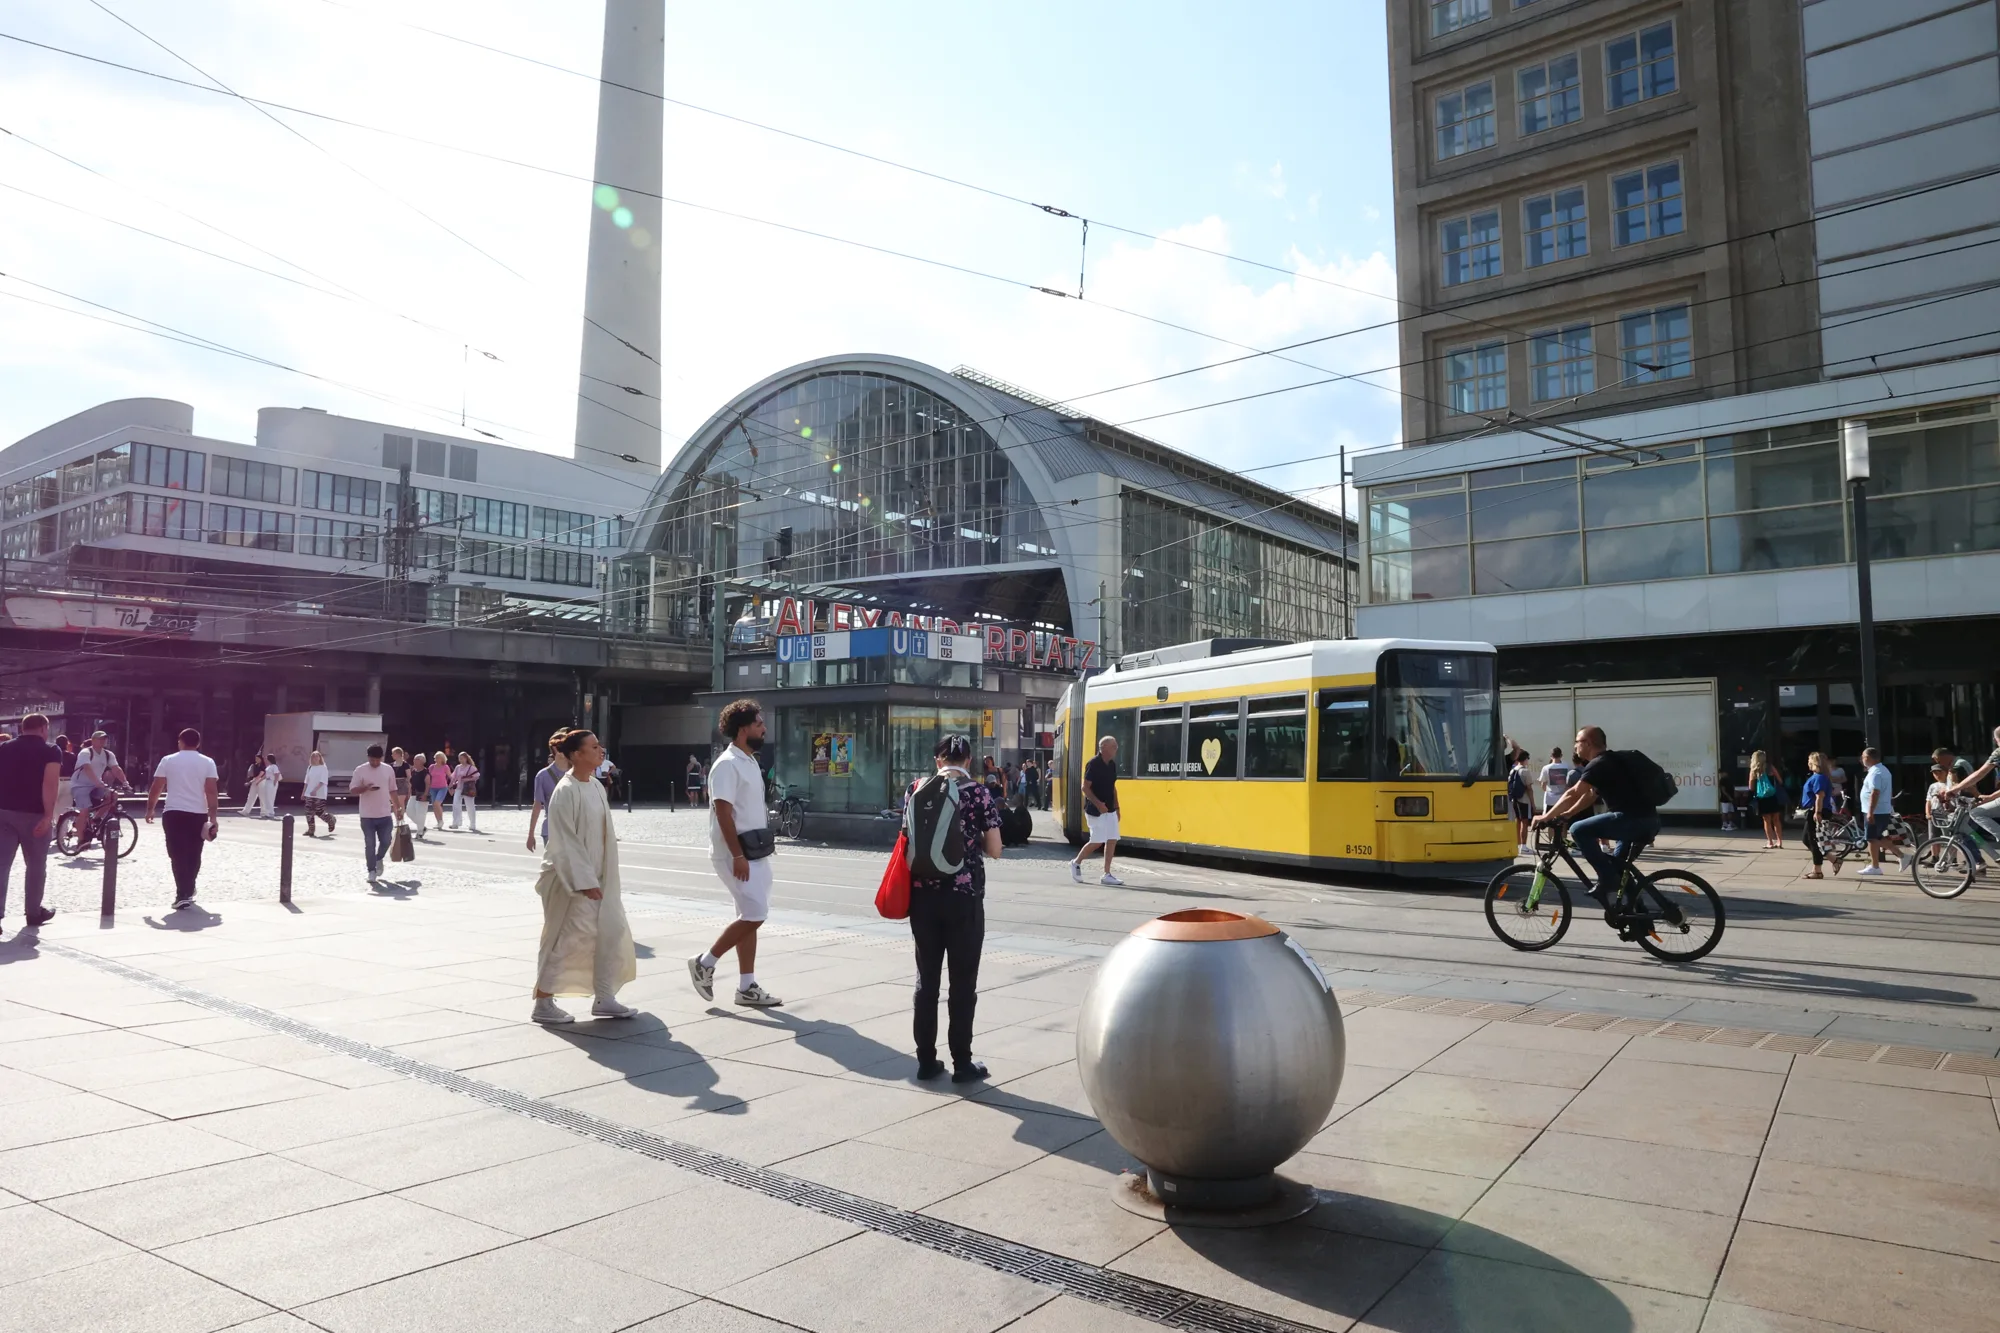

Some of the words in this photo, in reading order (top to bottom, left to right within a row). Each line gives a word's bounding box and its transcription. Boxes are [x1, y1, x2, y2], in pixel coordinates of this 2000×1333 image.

[814, 636, 825, 645] U8
[893, 629, 908, 654] U
[941, 636, 952, 645] U8
[779, 638, 792, 661] U
[814, 648, 825, 657] U5
[941, 649, 952, 658] U5
[1148, 763, 1159, 772] WEIL
[1160, 763, 1170, 772] WIR
[1346, 844, 1373, 856] B-1520
